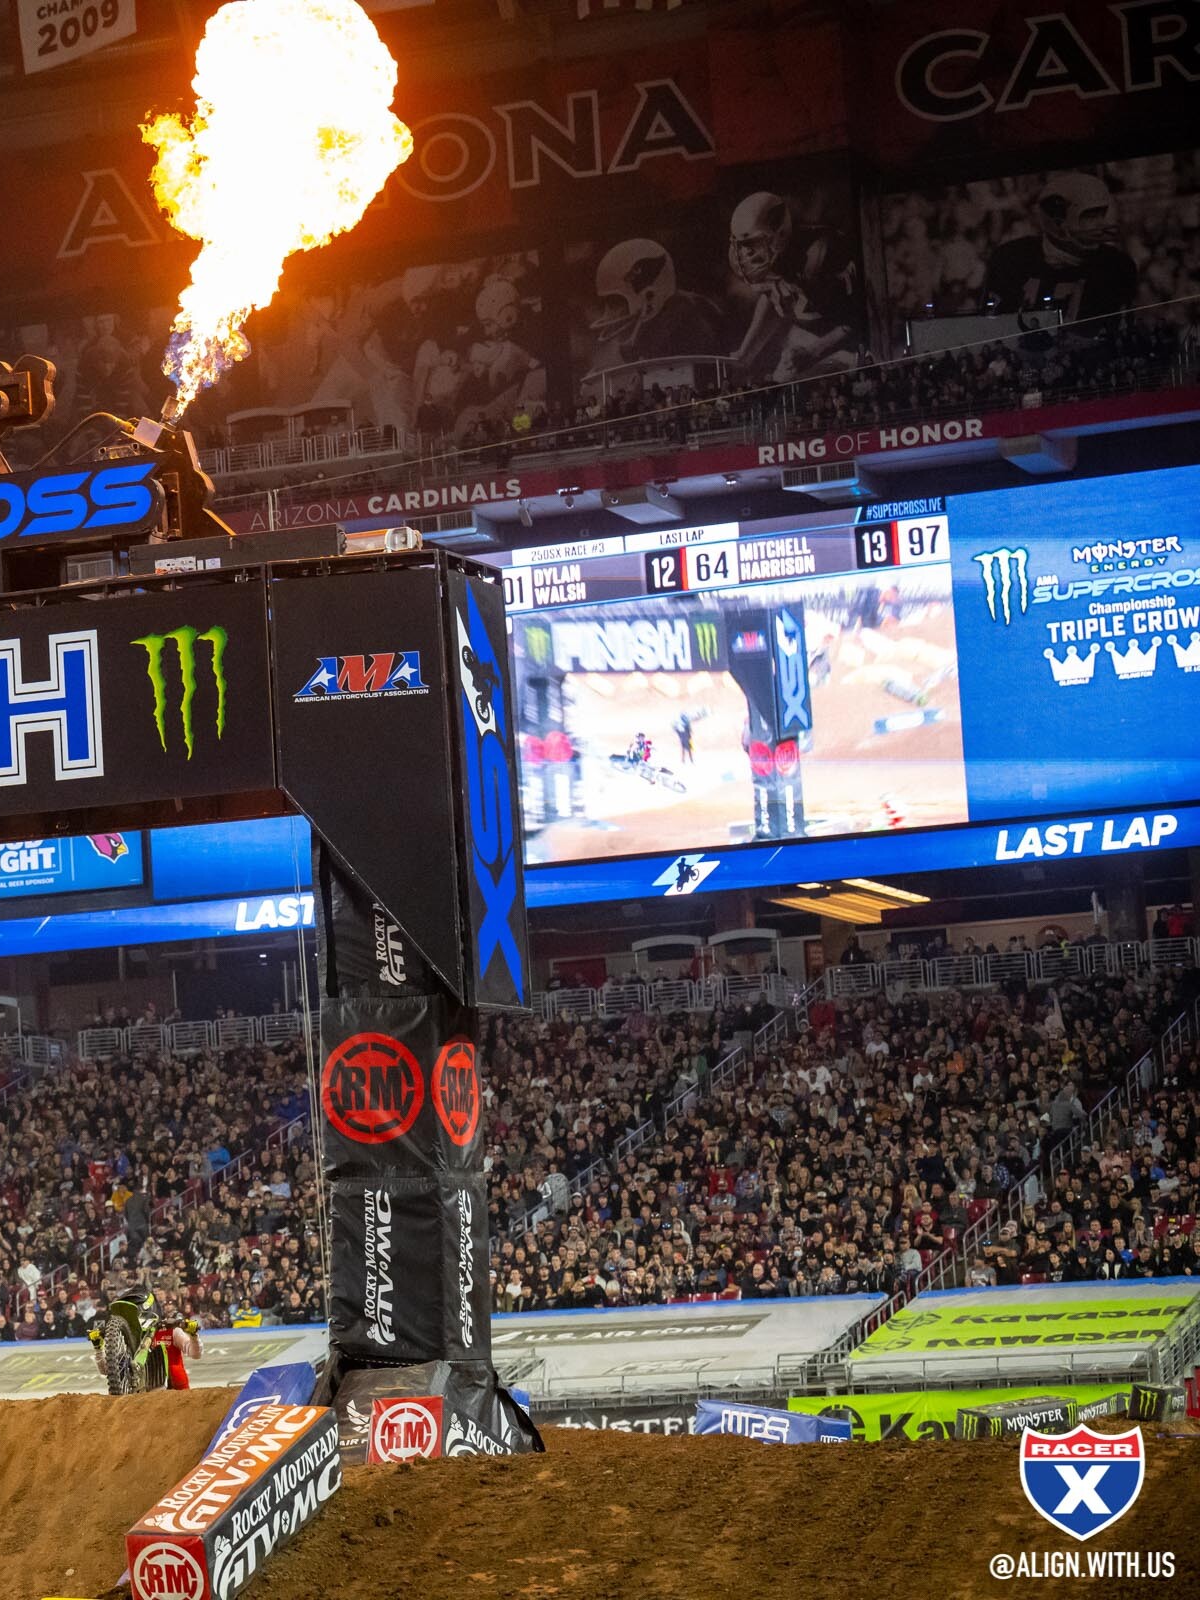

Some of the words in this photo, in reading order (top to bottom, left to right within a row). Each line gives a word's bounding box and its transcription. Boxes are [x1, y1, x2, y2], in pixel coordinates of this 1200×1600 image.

[38, 0, 119, 56] 2009
[895, 0, 1200, 122] CAR
[758, 438, 825, 465] RING
[835, 432, 871, 454] OF
[880, 419, 983, 448] HONOR
[250, 499, 360, 530] ARIZONA
[368, 479, 521, 514] CARDINALS
[866, 497, 942, 520] #SUPERCROSSLIVE
[565, 545, 588, 558] RACE
[659, 532, 683, 545] LAST
[685, 530, 704, 543] LAP
[739, 537, 811, 562] MITCHELL
[862, 531, 887, 563] 13
[908, 525, 941, 556] 97
[533, 564, 581, 587] DYLAN
[651, 556, 676, 588] 12
[696, 551, 728, 581] 64
[741, 555, 816, 580] HARRISON
[1036, 575, 1059, 587] AMA
[534, 583, 586, 605] WALSH
[1089, 595, 1176, 615] Championship
[1046, 615, 1126, 643] TRIPLE
[293, 651, 430, 697] AMA
[295, 695, 330, 703] AMERICAN
[331, 692, 383, 701] MOTORCYCLIST
[384, 689, 429, 697] ASSOCIATION
[995, 822, 1093, 860] LAST
[1101, 814, 1178, 850] LAP
[25, 877, 55, 886] SPONSOR
[235, 896, 314, 931] LAST
[375, 914, 388, 963] ROCKY
[365, 1189, 377, 1270] MOUNTAIN
[364, 1272, 377, 1320] ROCKY
[582, 1329, 637, 1341] AIR
[641, 1323, 750, 1337] FORCE
[387, 1421, 424, 1450] RM
[158, 1469, 215, 1510] ROCKY
[204, 1405, 284, 1469] MOUNTAIN
[232, 1486, 271, 1545] ROCKY
[274, 1423, 339, 1504] MOUNTAIN
[150, 1564, 193, 1594] RM
